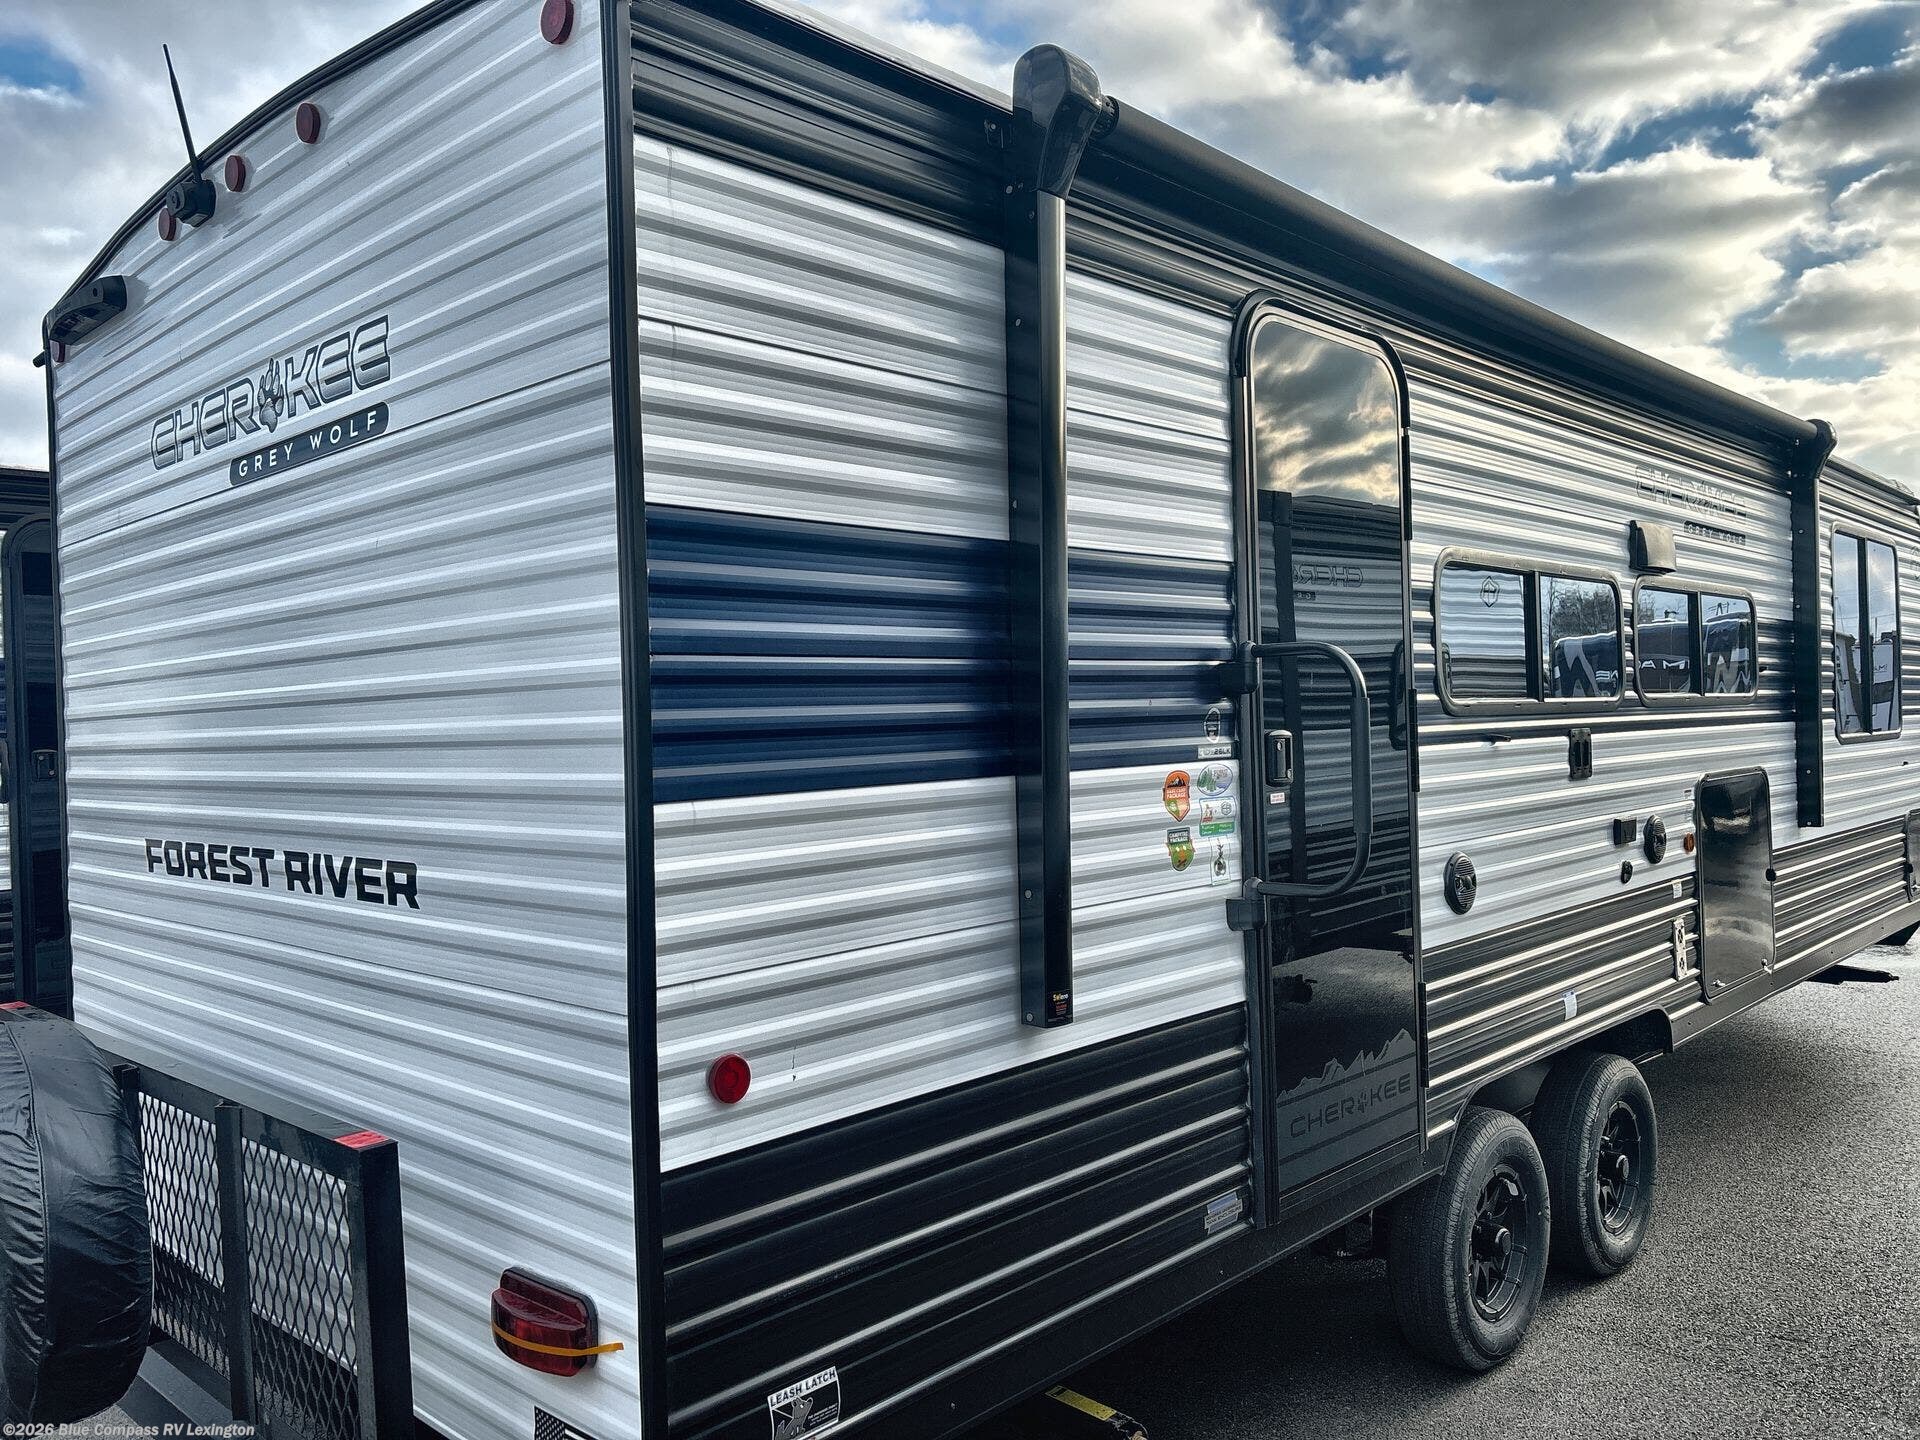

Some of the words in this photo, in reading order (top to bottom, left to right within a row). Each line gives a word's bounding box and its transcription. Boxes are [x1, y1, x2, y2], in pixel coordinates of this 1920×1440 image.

[238, 442, 295, 477] GREY
[309, 410, 379, 449] WOLF
[145, 838, 275, 888] FOREST
[283, 850, 421, 910] RIVER
[770, 1384, 803, 1407] LEASH
[805, 1370, 837, 1391] LATCH
